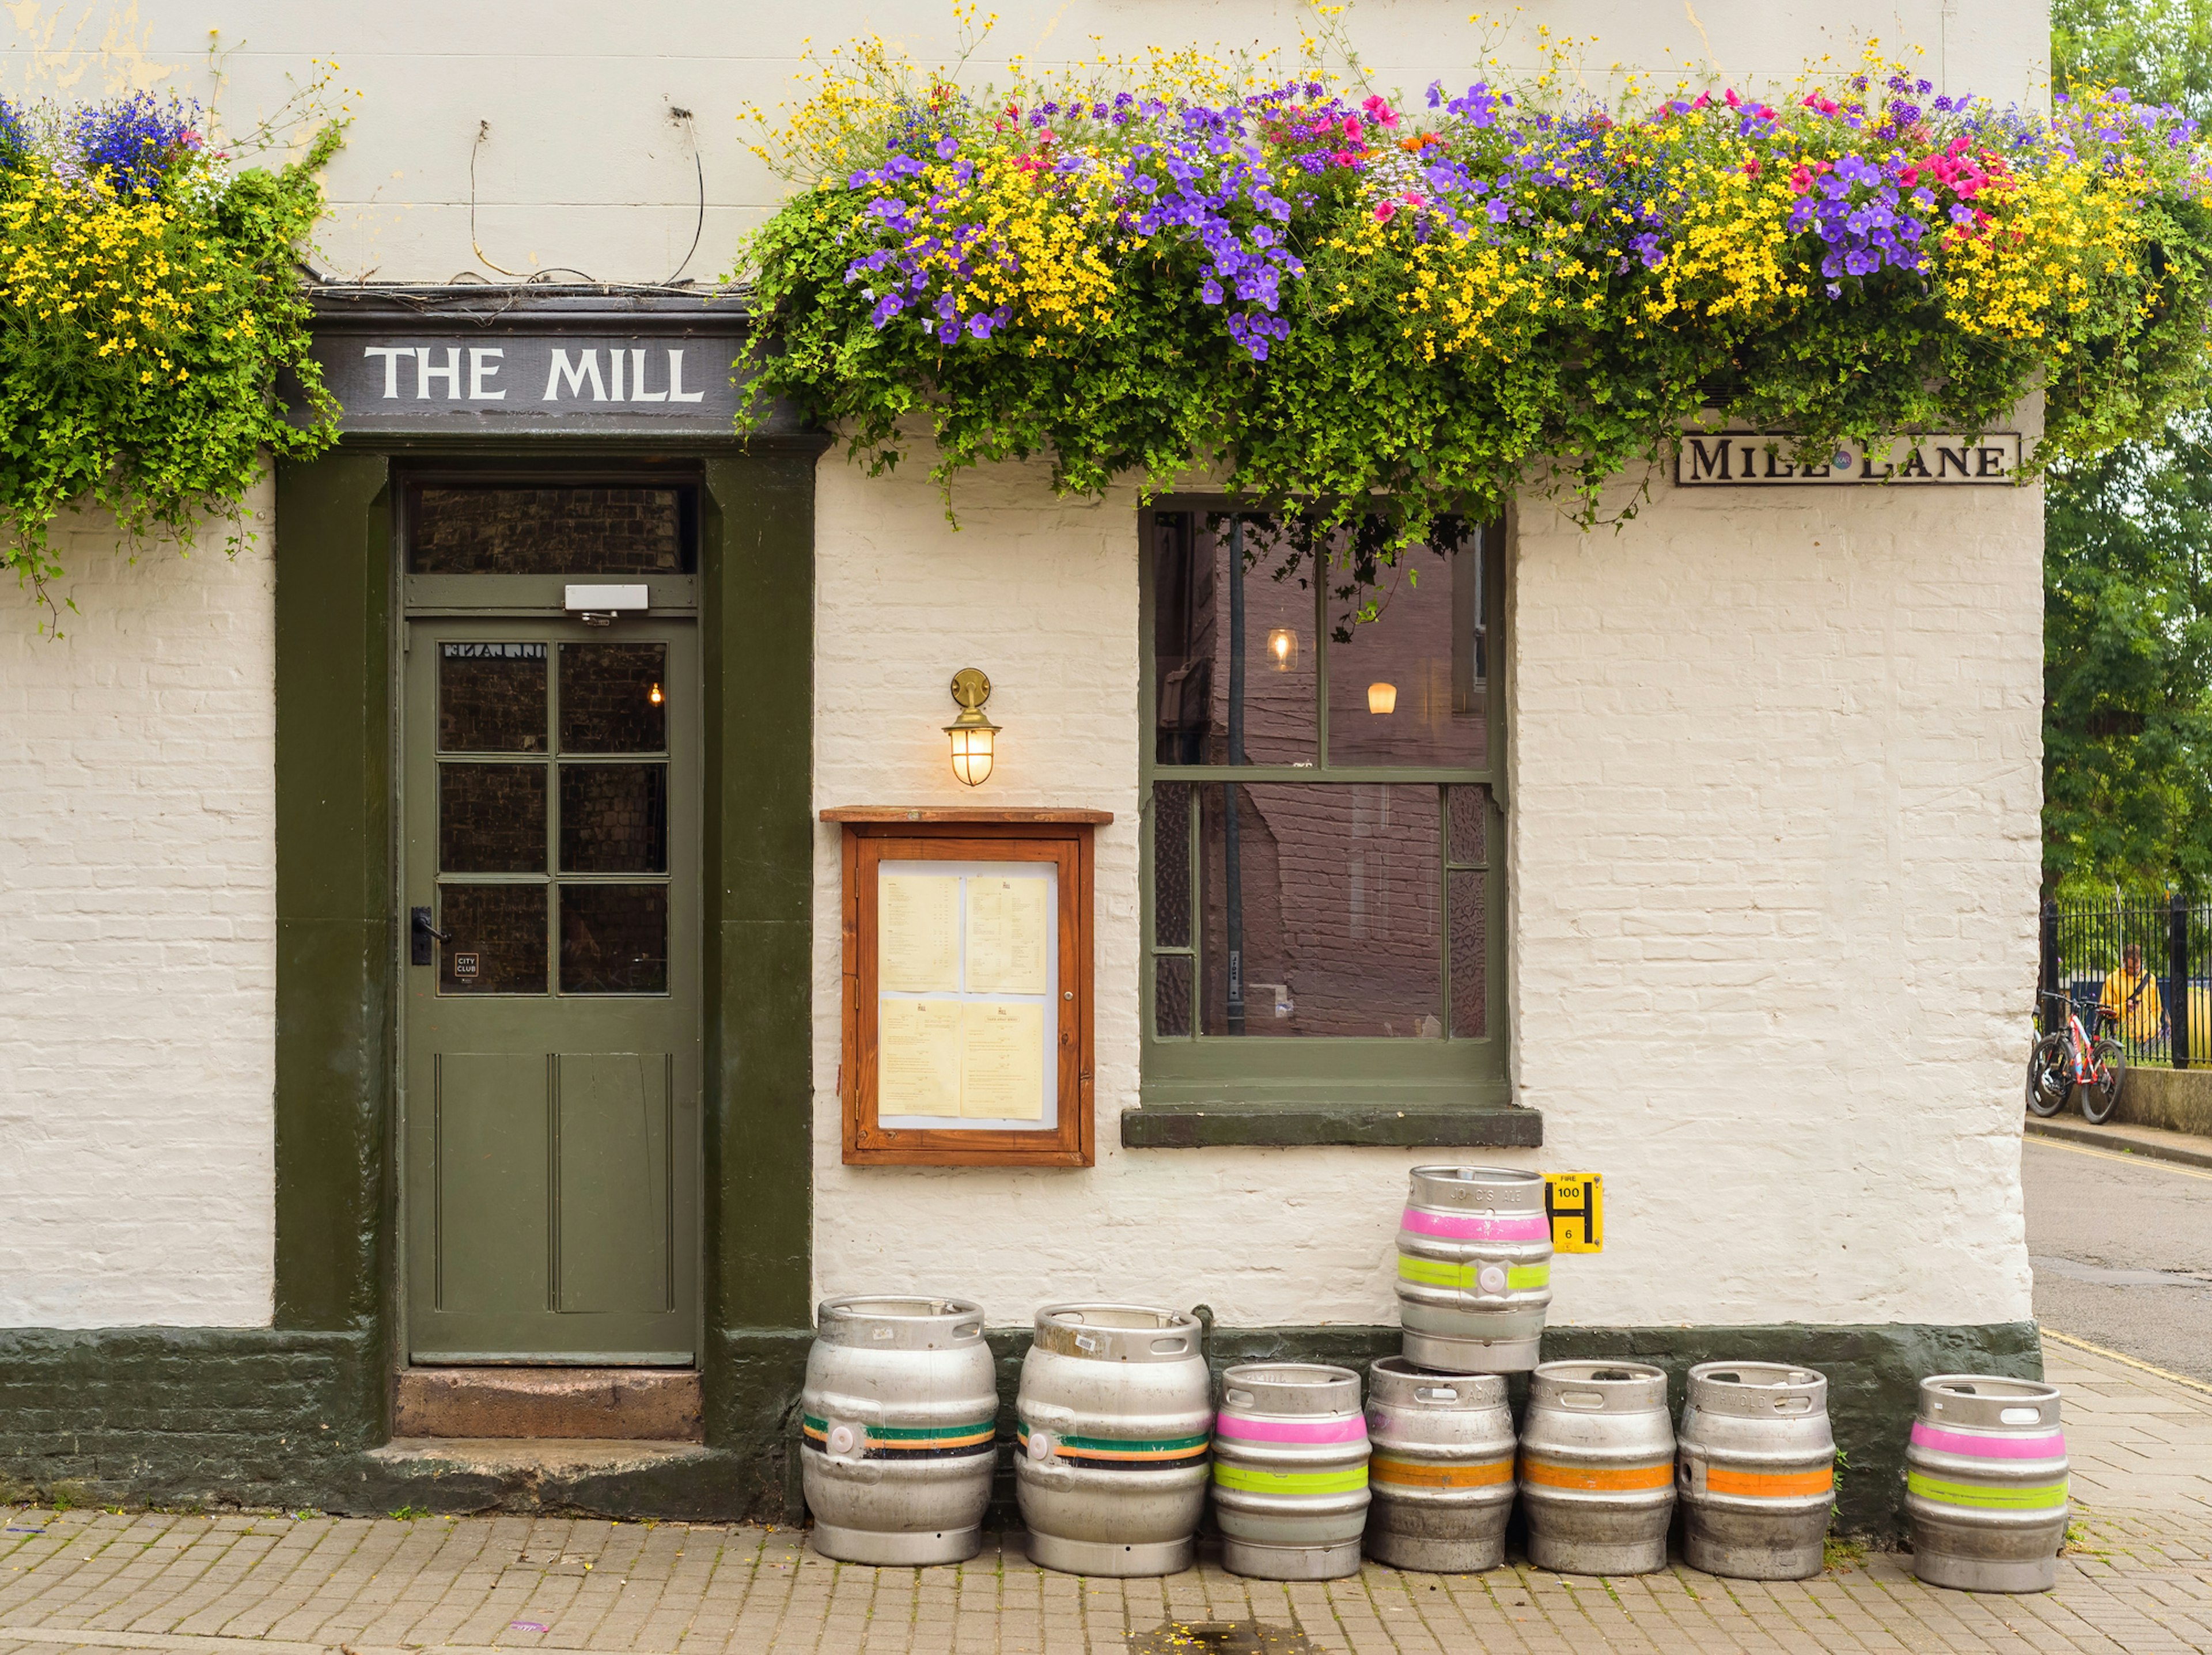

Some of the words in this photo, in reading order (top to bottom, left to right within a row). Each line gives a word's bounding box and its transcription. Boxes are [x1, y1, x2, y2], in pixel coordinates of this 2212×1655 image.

[364, 347, 506, 400] THE
[543, 349, 704, 402] MILL
[1558, 1188, 1580, 1198] 100
[1565, 1229, 1573, 1239] 6
[1694, 1386, 1766, 1409] SOUTHWOLD
